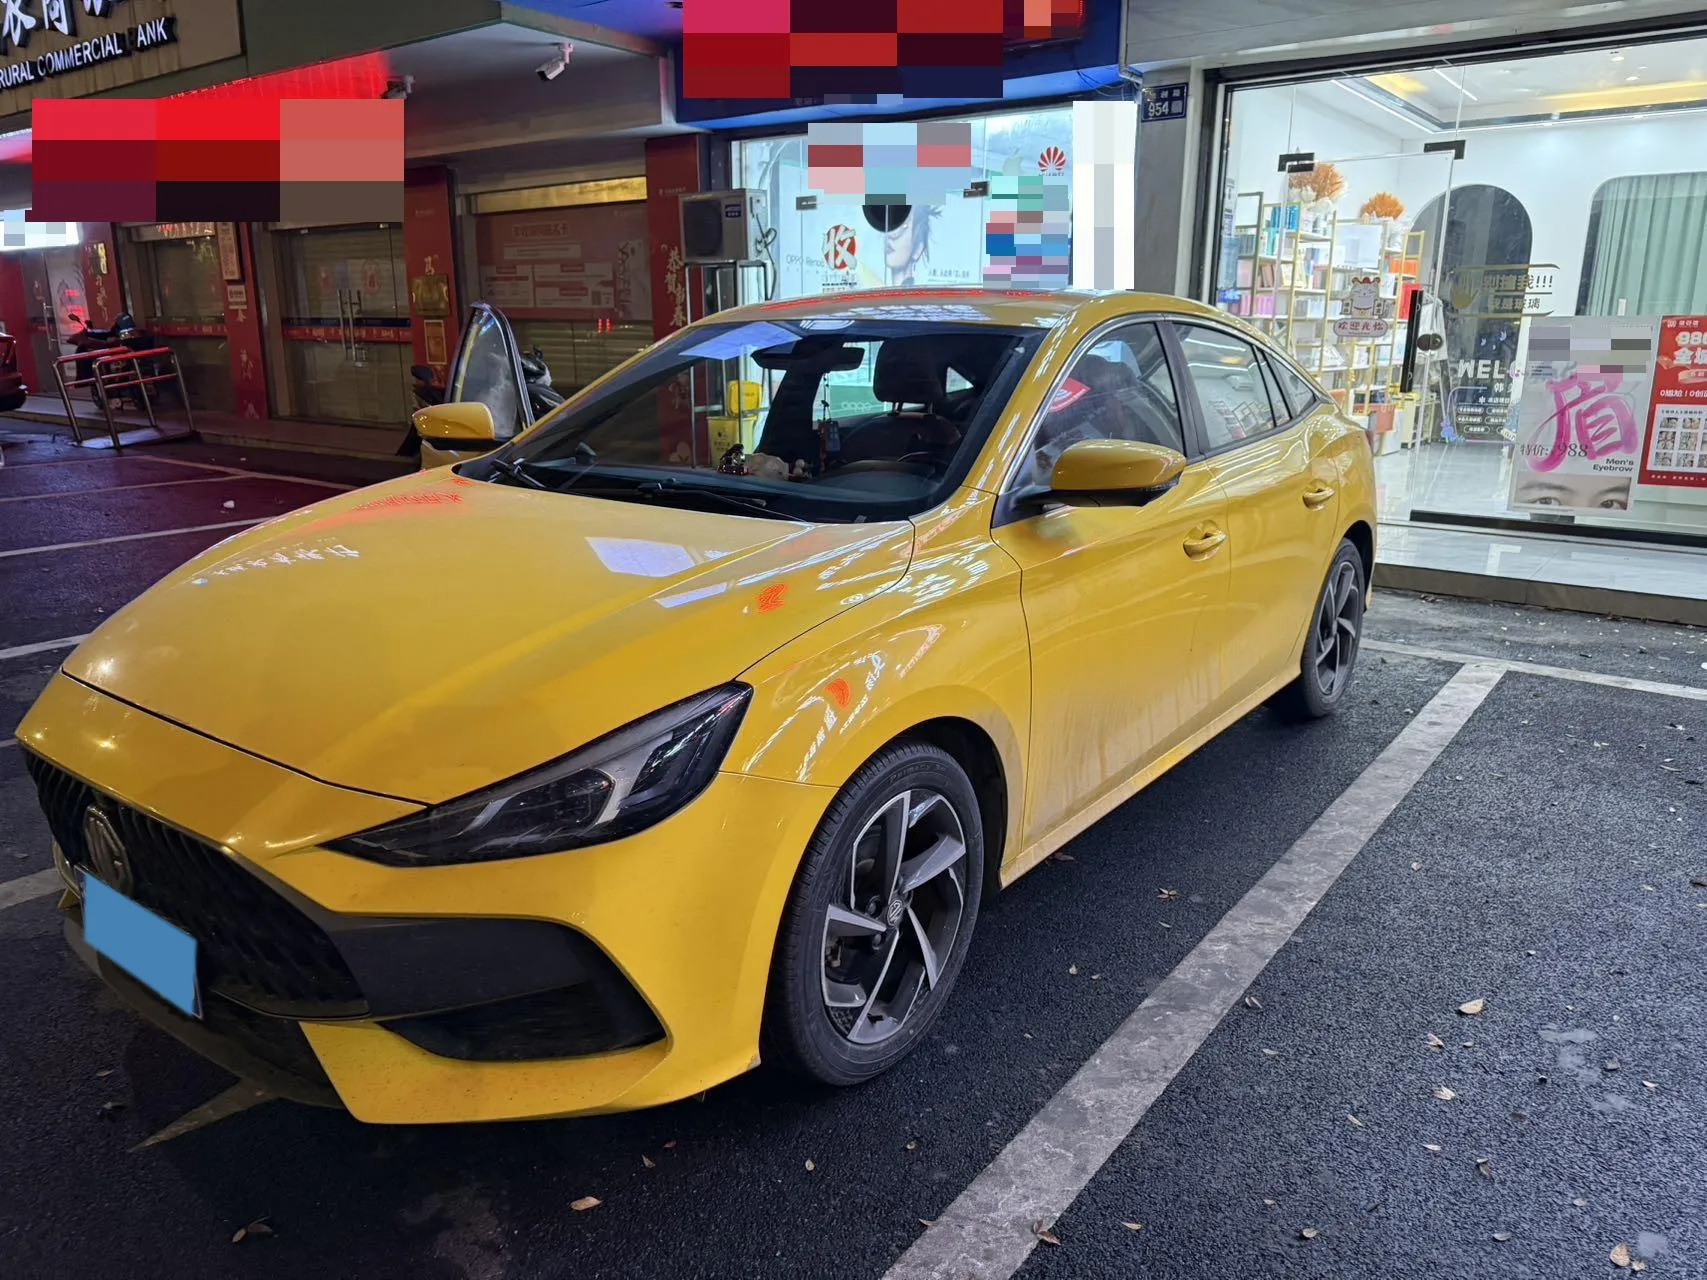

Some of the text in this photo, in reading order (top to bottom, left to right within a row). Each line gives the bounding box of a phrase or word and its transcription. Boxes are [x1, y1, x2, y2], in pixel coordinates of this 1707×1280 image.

[37, 33, 122, 76] COMMERCIAL
[822, 223, 858, 270] 收
[1592, 463, 1634, 472] Eyebrow
[1605, 458, 1635, 466] Men's
